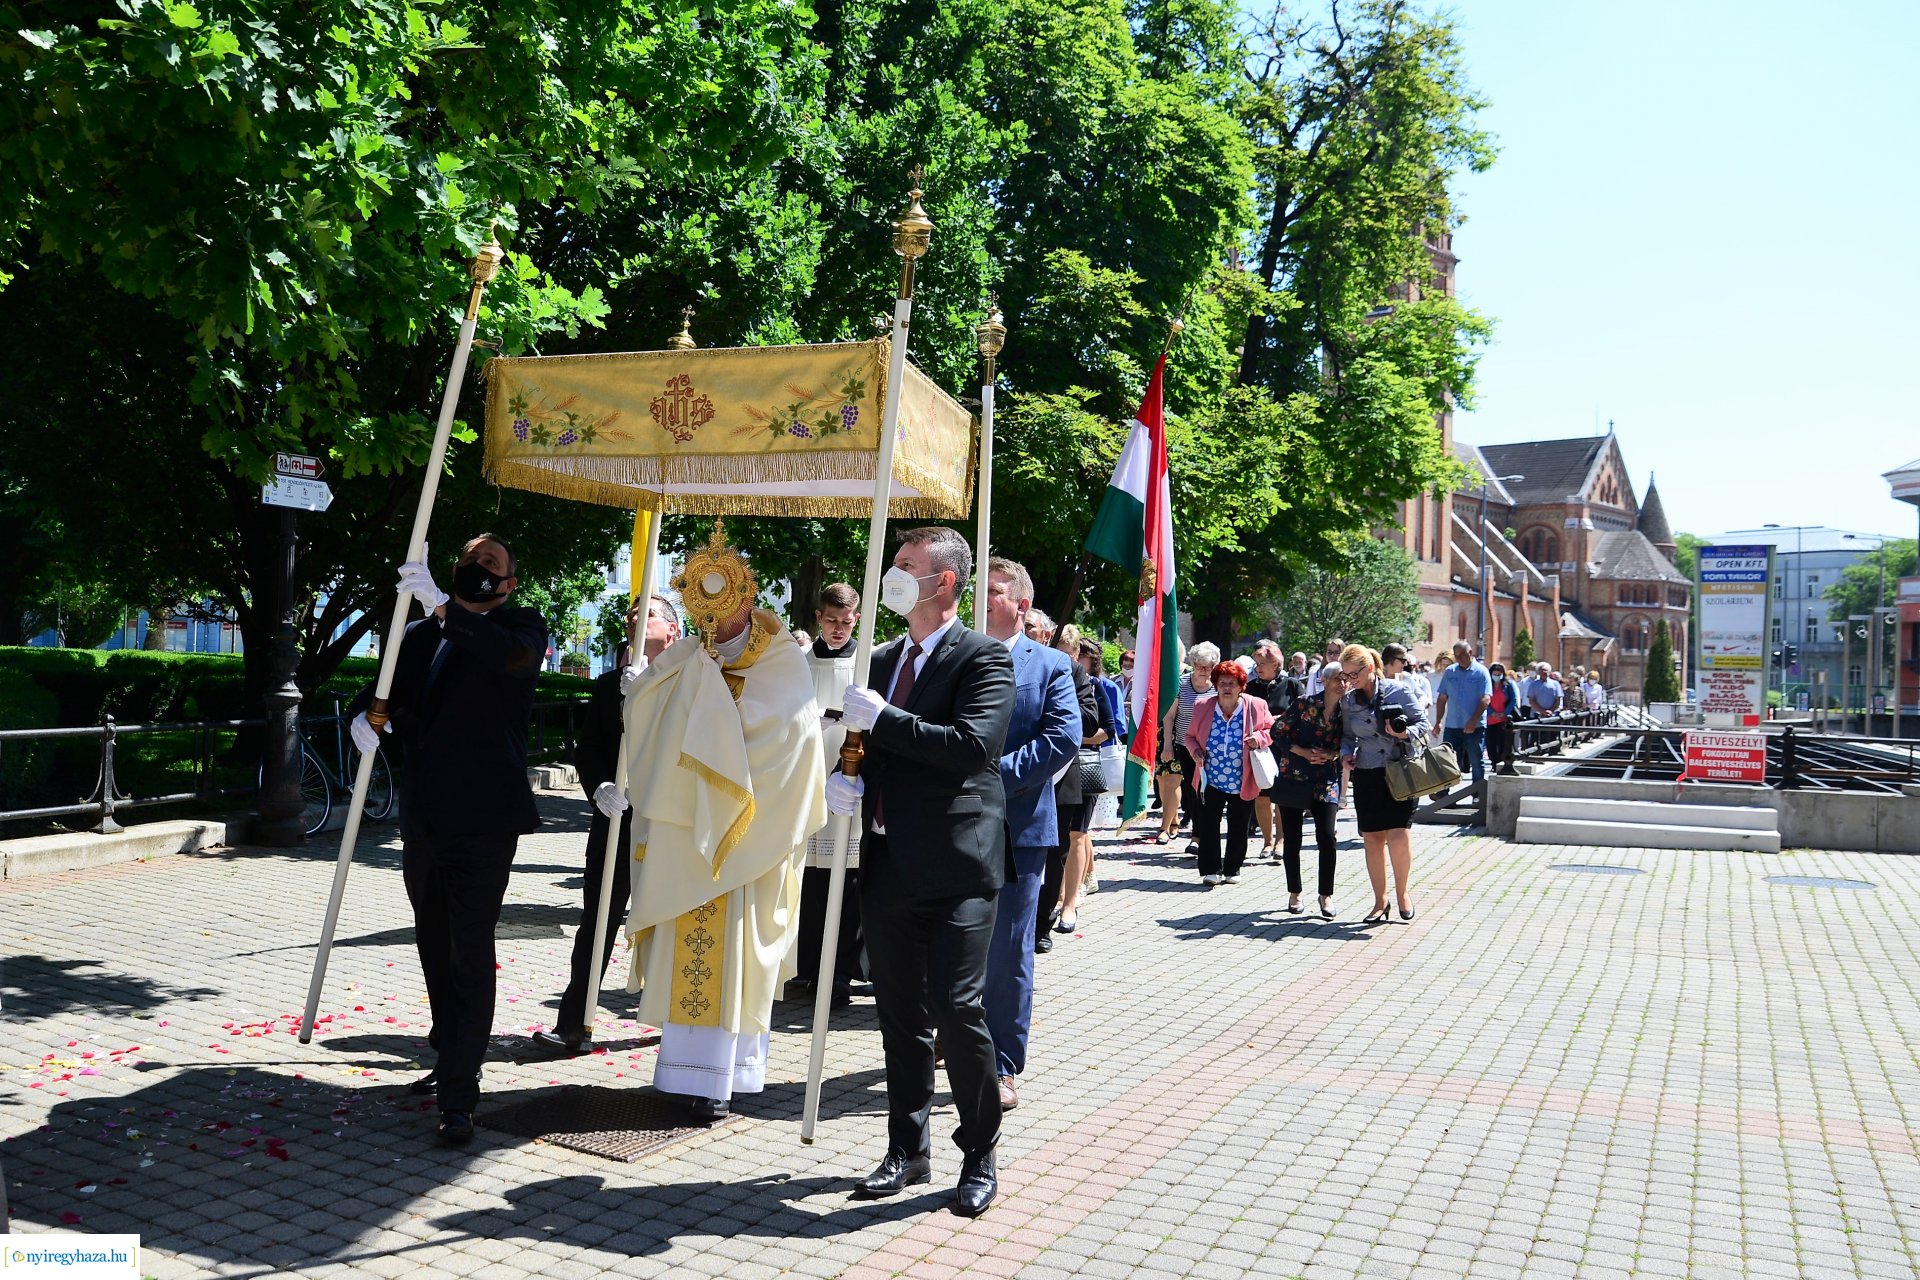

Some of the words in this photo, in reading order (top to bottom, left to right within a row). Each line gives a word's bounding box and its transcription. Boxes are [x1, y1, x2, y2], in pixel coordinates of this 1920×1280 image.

[1715, 560, 1742, 568] OPEN
[1744, 560, 1764, 568] KFT.
[1703, 573, 1727, 581] TOM
[1728, 573, 1762, 581] TAILOR
[1690, 734, 1763, 747] ÉLETVESZÉLY!
[1701, 749, 1750, 759] FOKOZOTTAN
[1688, 758, 1762, 769] BALESETVESZÉLYES
[1706, 769, 1742, 778] TERÜLET!
